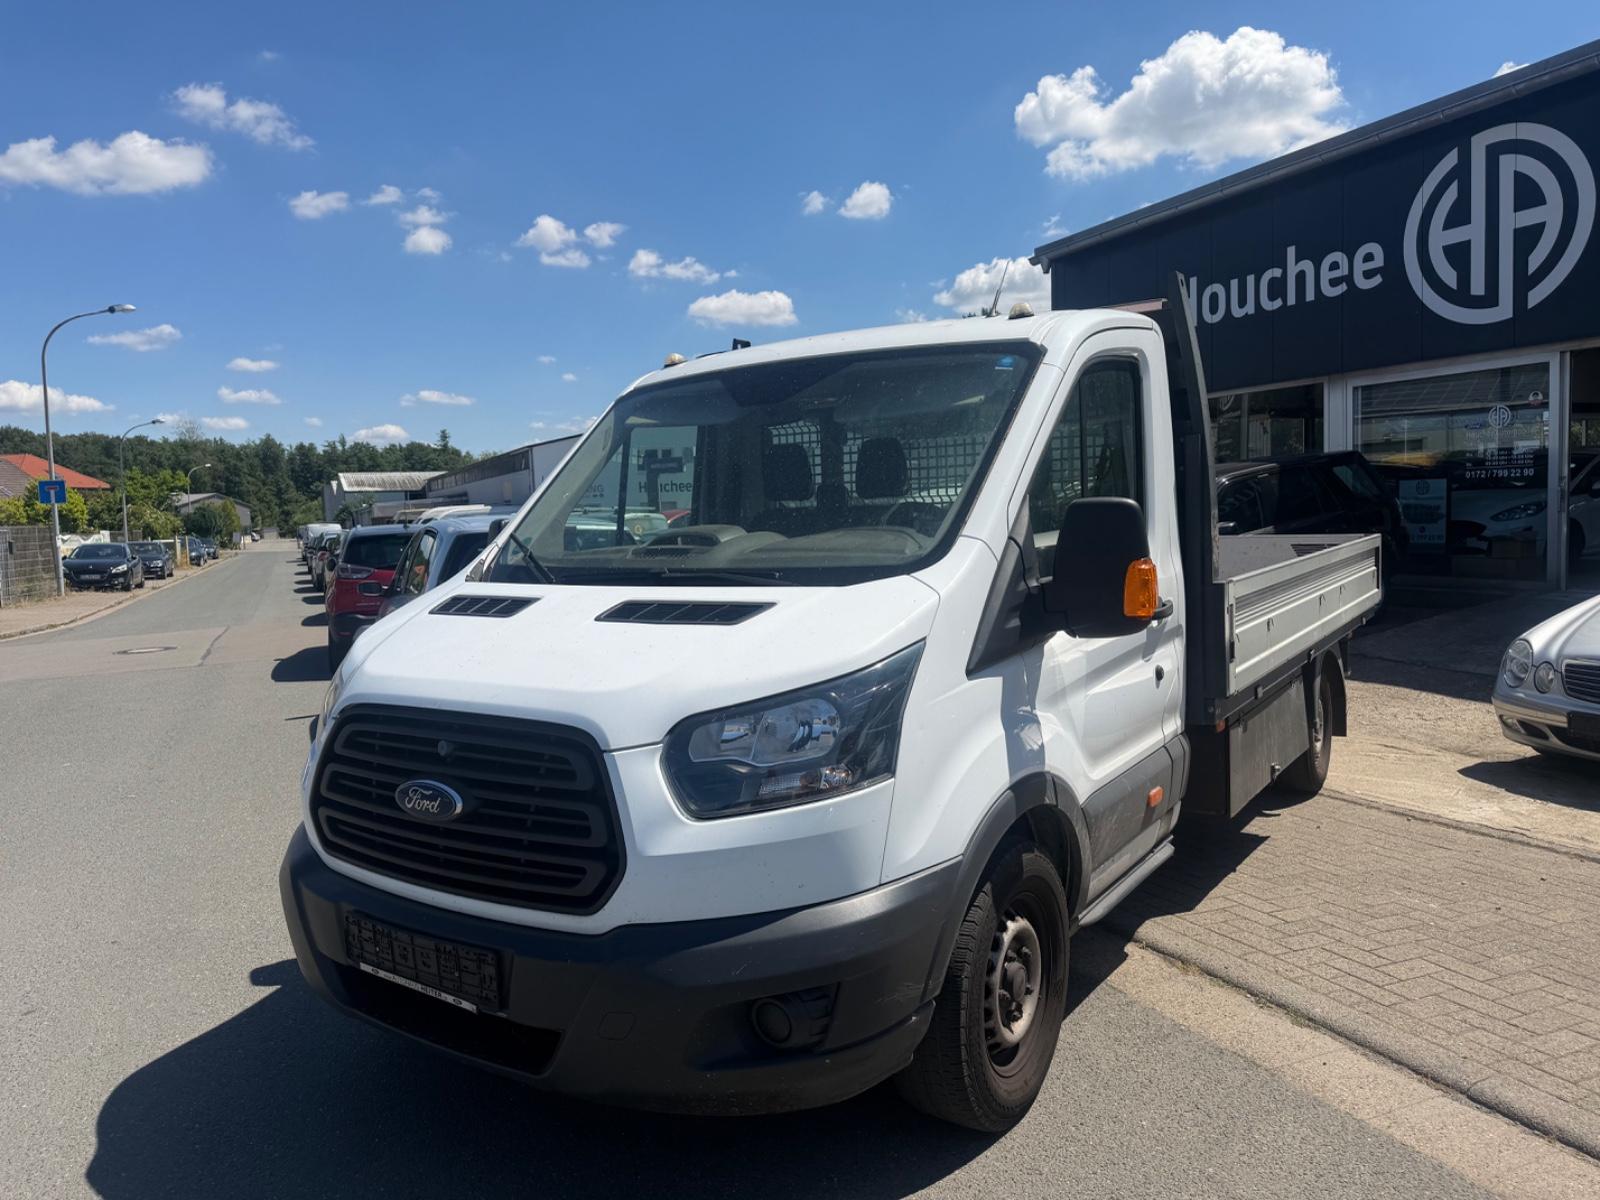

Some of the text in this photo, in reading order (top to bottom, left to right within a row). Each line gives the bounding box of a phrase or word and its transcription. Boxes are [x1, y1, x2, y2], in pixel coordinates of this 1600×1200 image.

[1465, 470, 1486, 479] 0172
[1510, 468, 1521, 477] 22
[1523, 467, 1535, 477] 90
[638, 479, 693, 494] Hchee
[405, 786, 441, 814] Ford
